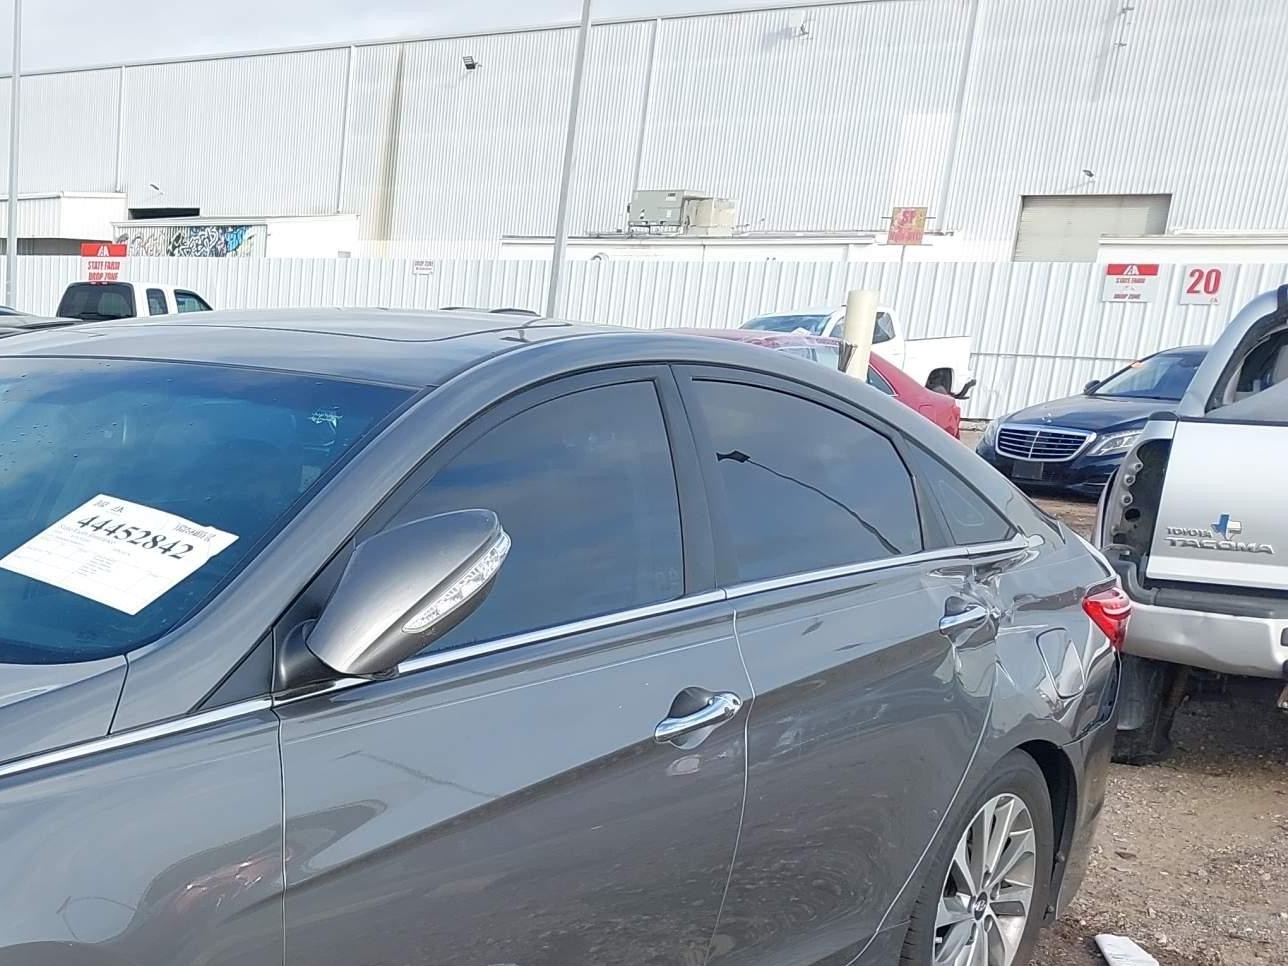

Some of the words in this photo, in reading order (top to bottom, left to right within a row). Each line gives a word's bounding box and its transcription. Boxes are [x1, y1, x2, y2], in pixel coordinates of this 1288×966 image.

[88, 261, 104, 270] STATE
[105, 262, 120, 270] FARM
[88, 272, 104, 281] DROP
[104, 272, 119, 281] ZONE
[1186, 269, 1222, 295] 20
[76, 515, 194, 560] 44452842
[1167, 527, 1212, 539] TOYOTA
[1164, 537, 1275, 555] TACOMA
